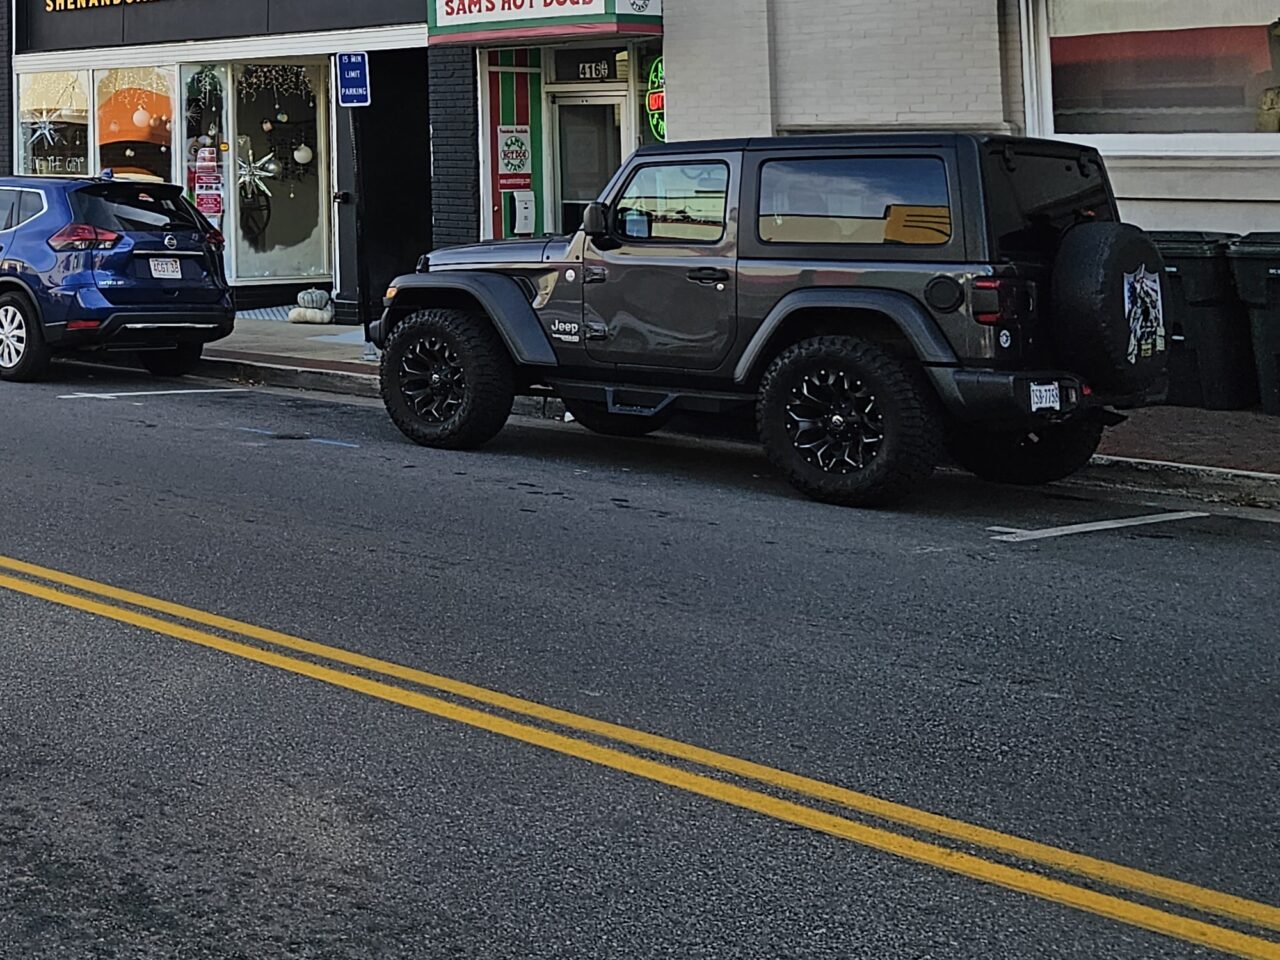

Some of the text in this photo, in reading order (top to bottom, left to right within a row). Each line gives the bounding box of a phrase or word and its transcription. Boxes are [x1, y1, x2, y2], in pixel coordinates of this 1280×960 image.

[342, 55, 349, 63] 15
[345, 70, 361, 78] LIMIT
[341, 87, 367, 96] PARKING
[551, 319, 579, 334] Jeep
